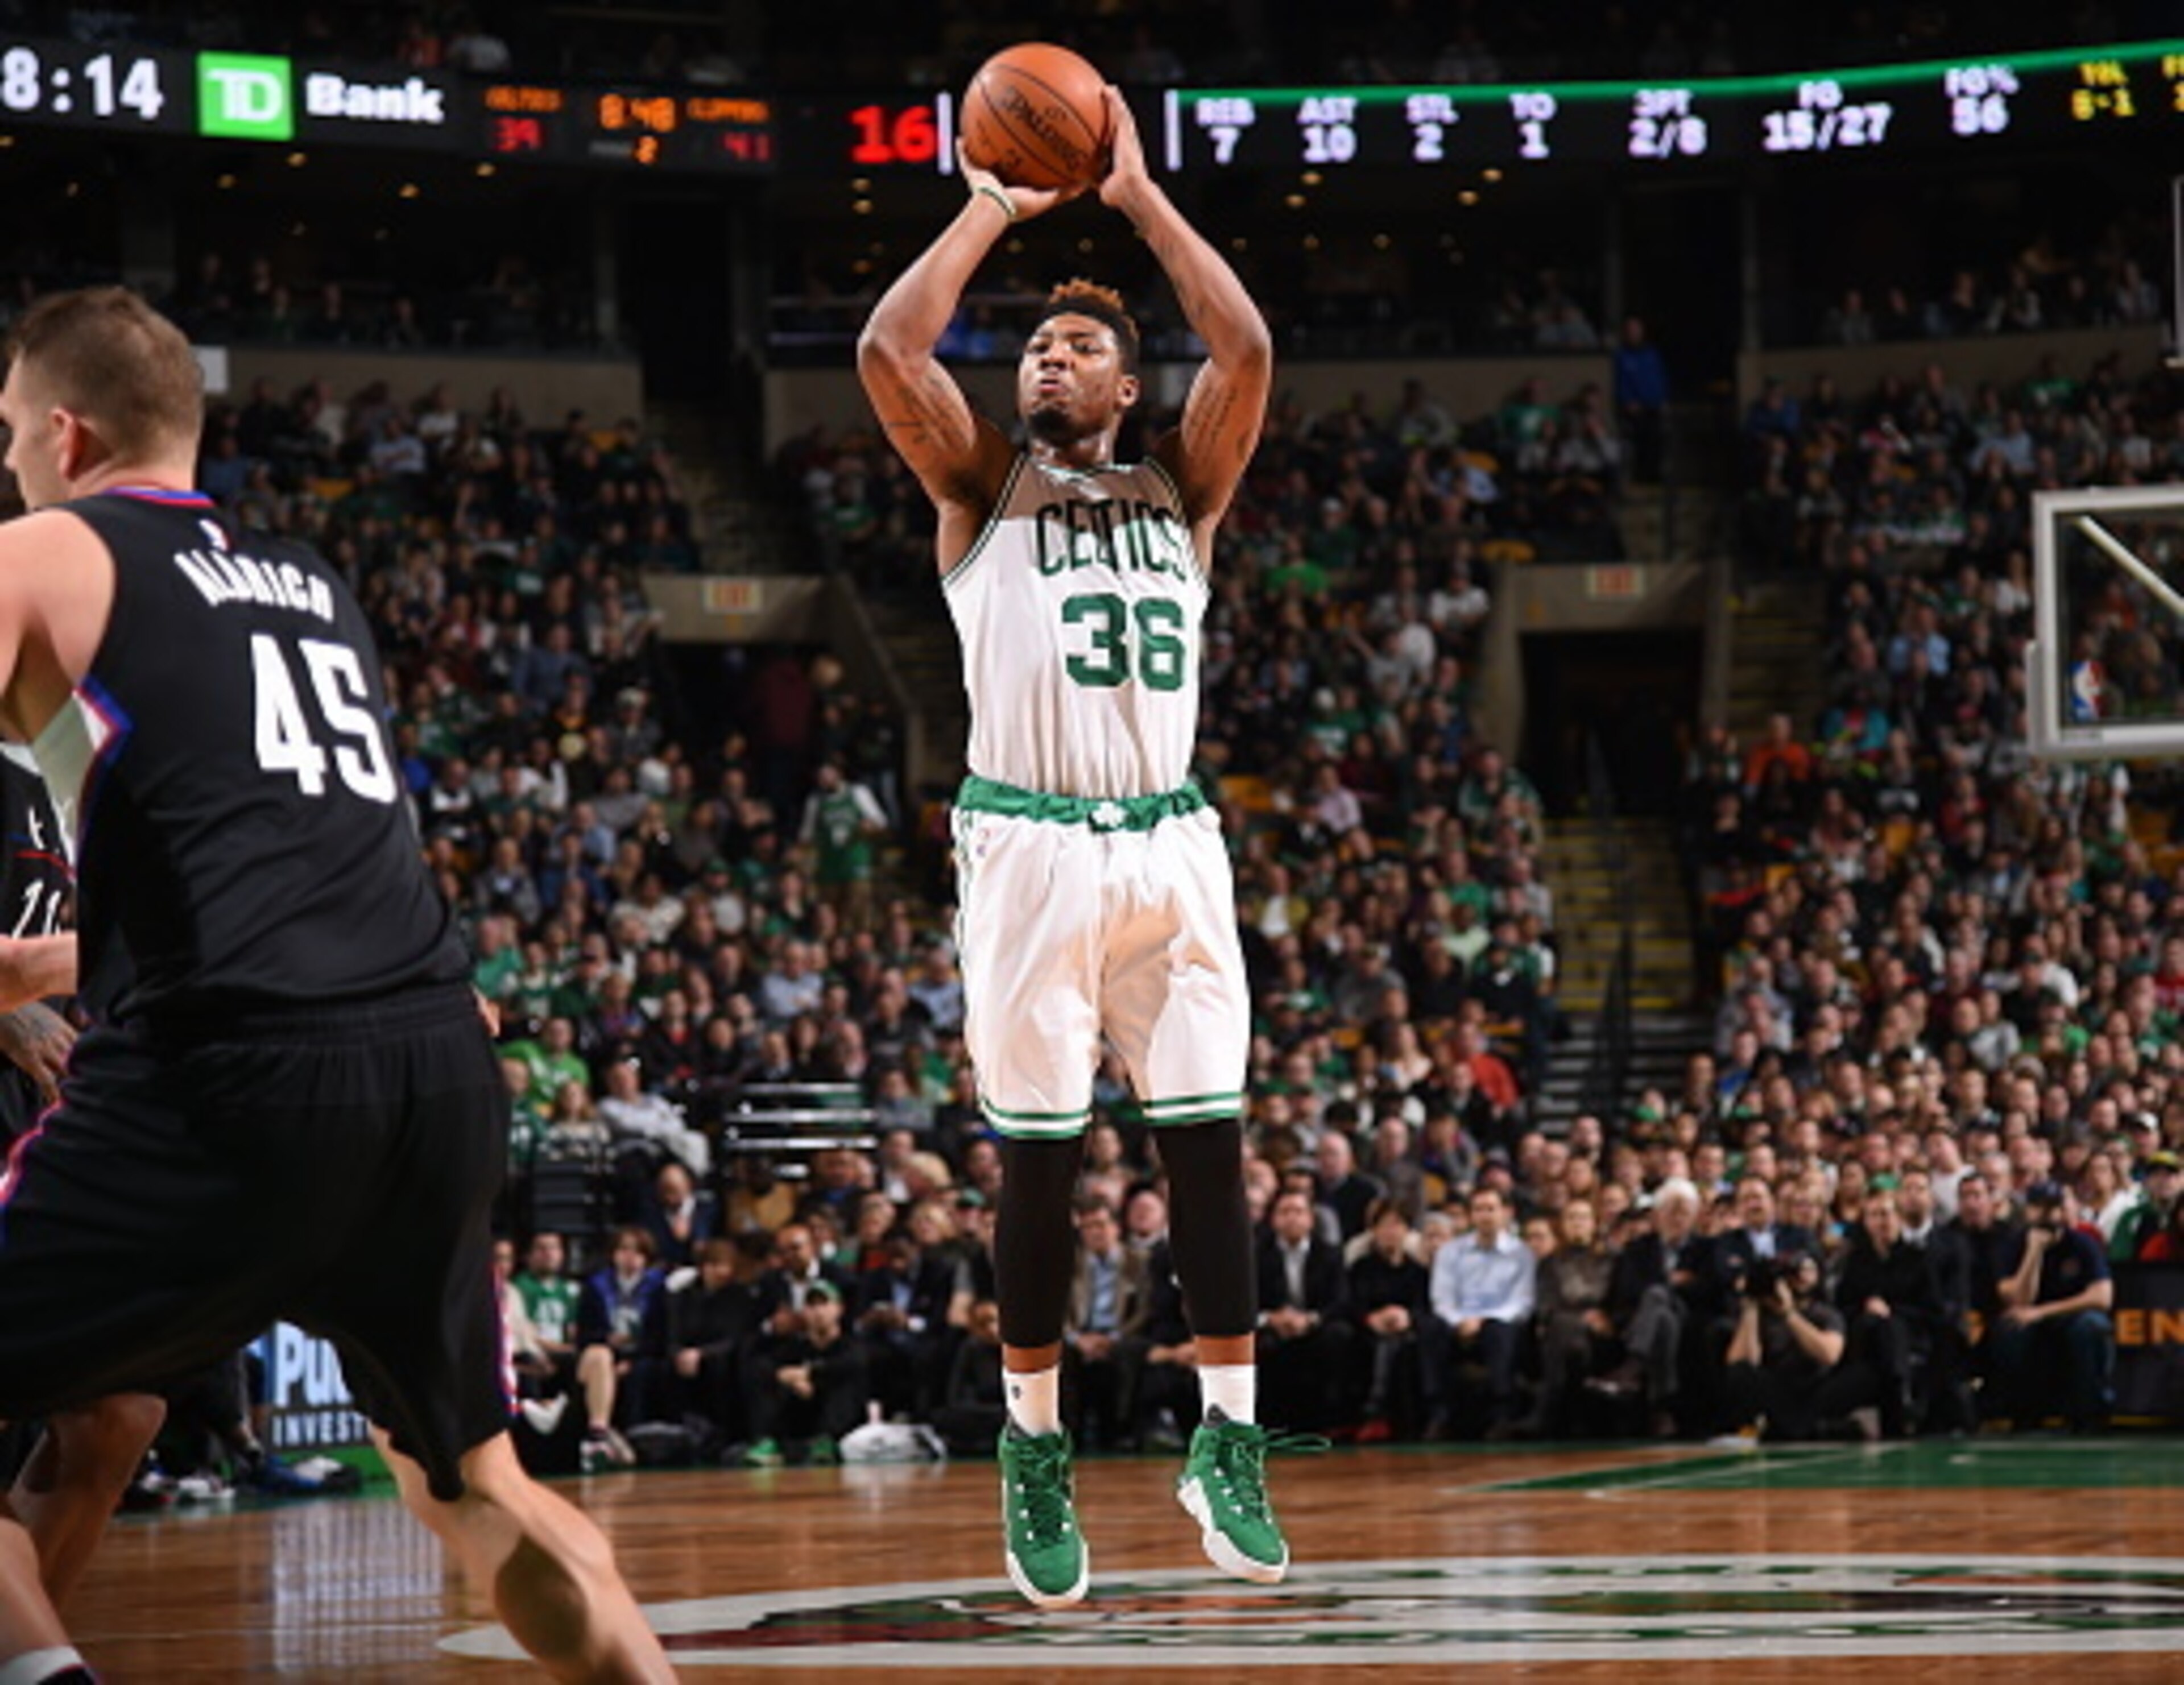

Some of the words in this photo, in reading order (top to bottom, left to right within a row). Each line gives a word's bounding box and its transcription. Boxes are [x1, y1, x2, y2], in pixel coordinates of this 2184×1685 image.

[1, 47, 164, 120] 8:14
[205, 68, 285, 123] TD
[305, 72, 445, 123] Bank
[1509, 93, 1557, 121] TO
[849, 105, 938, 164] 16
[1297, 96, 1358, 125] AST
[1764, 102, 1893, 152] 15/27
[1210, 126, 1240, 164] 7
[1303, 123, 1356, 162] 10
[1414, 123, 1444, 161] 2
[1520, 121, 1550, 159] 1
[1035, 498, 1188, 585] CELTICS
[1061, 593, 1186, 692] 36
[250, 632, 397, 804] 45
